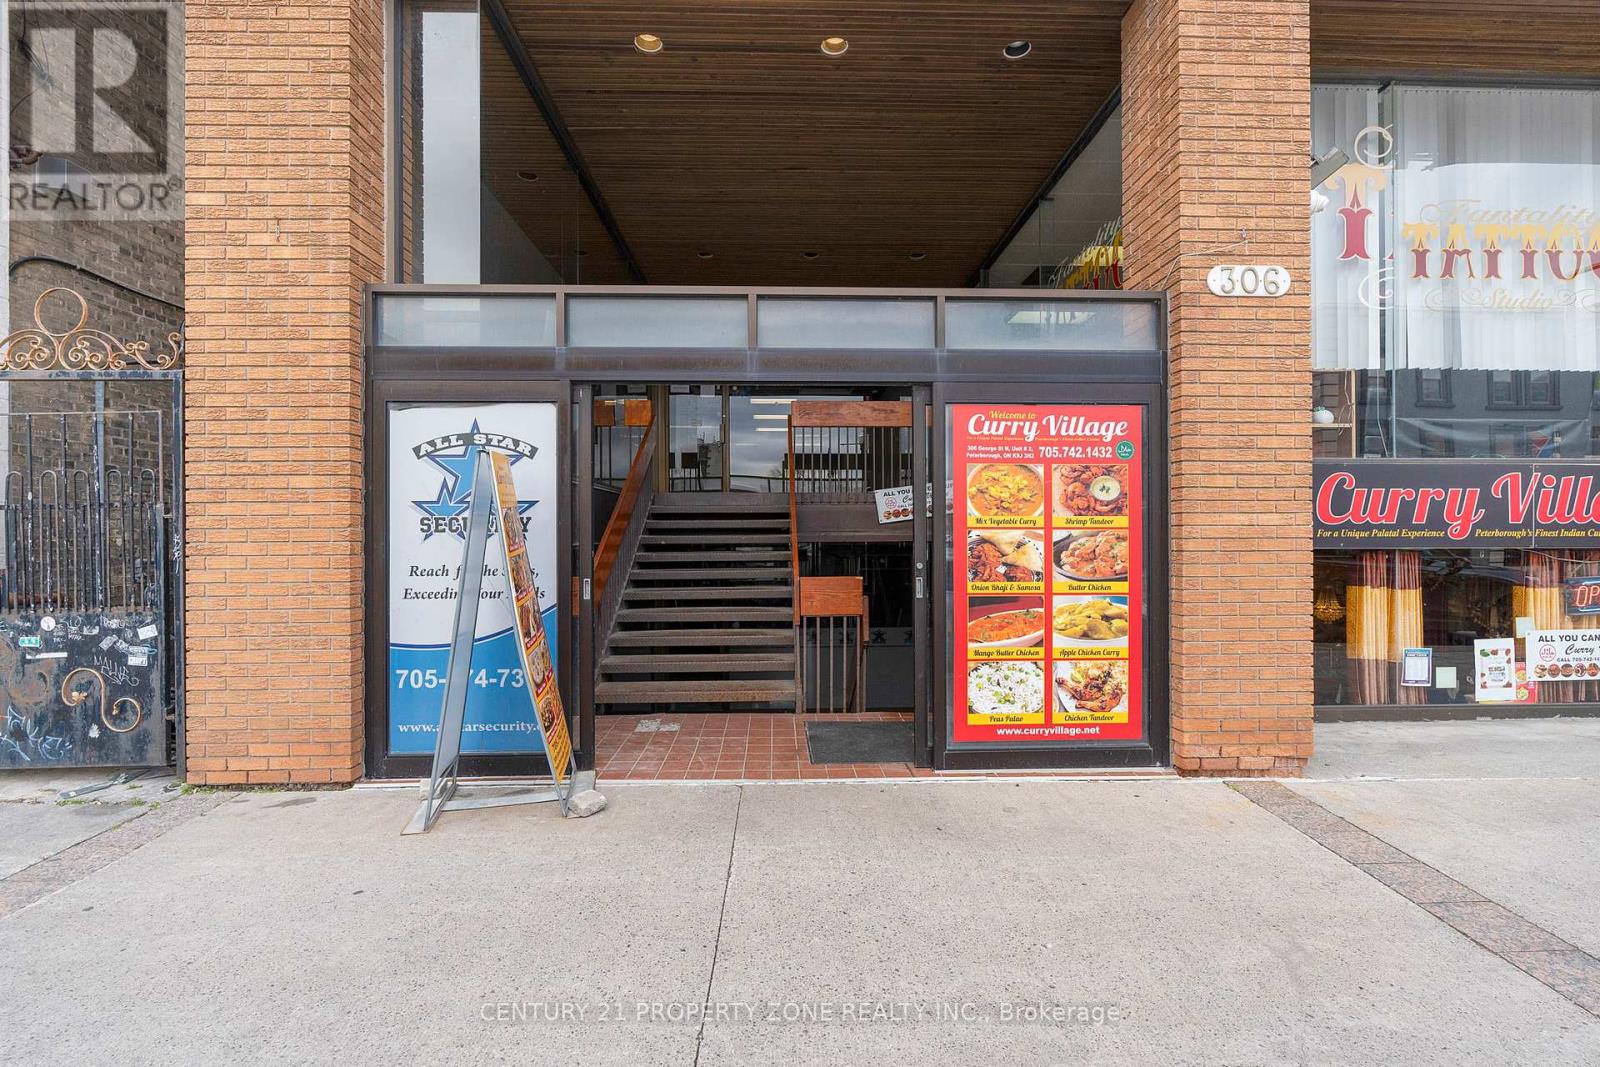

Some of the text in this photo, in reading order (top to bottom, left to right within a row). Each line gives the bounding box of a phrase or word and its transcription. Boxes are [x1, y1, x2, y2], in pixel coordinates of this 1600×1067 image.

[1220, 266, 1280, 295] 306
[989, 410, 1025, 420] Welcome
[967, 413, 1129, 442] Curry Village
[419, 433, 532, 456] ALL STAR
[1039, 446, 1112, 458] 705.742.1432
[1316, 471, 1485, 540] Curry
[989, 517, 1017, 526] Vegetable
[1019, 517, 1037, 526] Curry
[1065, 518, 1087, 526] Shrimp
[1317, 529, 1332, 537] For
[1340, 529, 1369, 539] Unique
[1371, 529, 1400, 537] Palatal
[1401, 529, 1445, 539] Experience
[1475, 528, 1533, 539] Peterborough's
[1534, 529, 1558, 537] Finest
[1560, 529, 1586, 537] Indian
[409, 564, 449, 577] Reach
[484, 565, 498, 577] he
[971, 584, 990, 592] Onion
[991, 584, 1009, 592] Bhaji
[1538, 634, 1600, 643] ALL YOU CAN
[973, 650, 994, 658] Mango
[1060, 649, 1076, 658] Apple
[1102, 649, 1120, 658] Curry
[1565, 643, 1595, 656] Curry
[996, 725, 1100, 736] www.curryvillage.net
